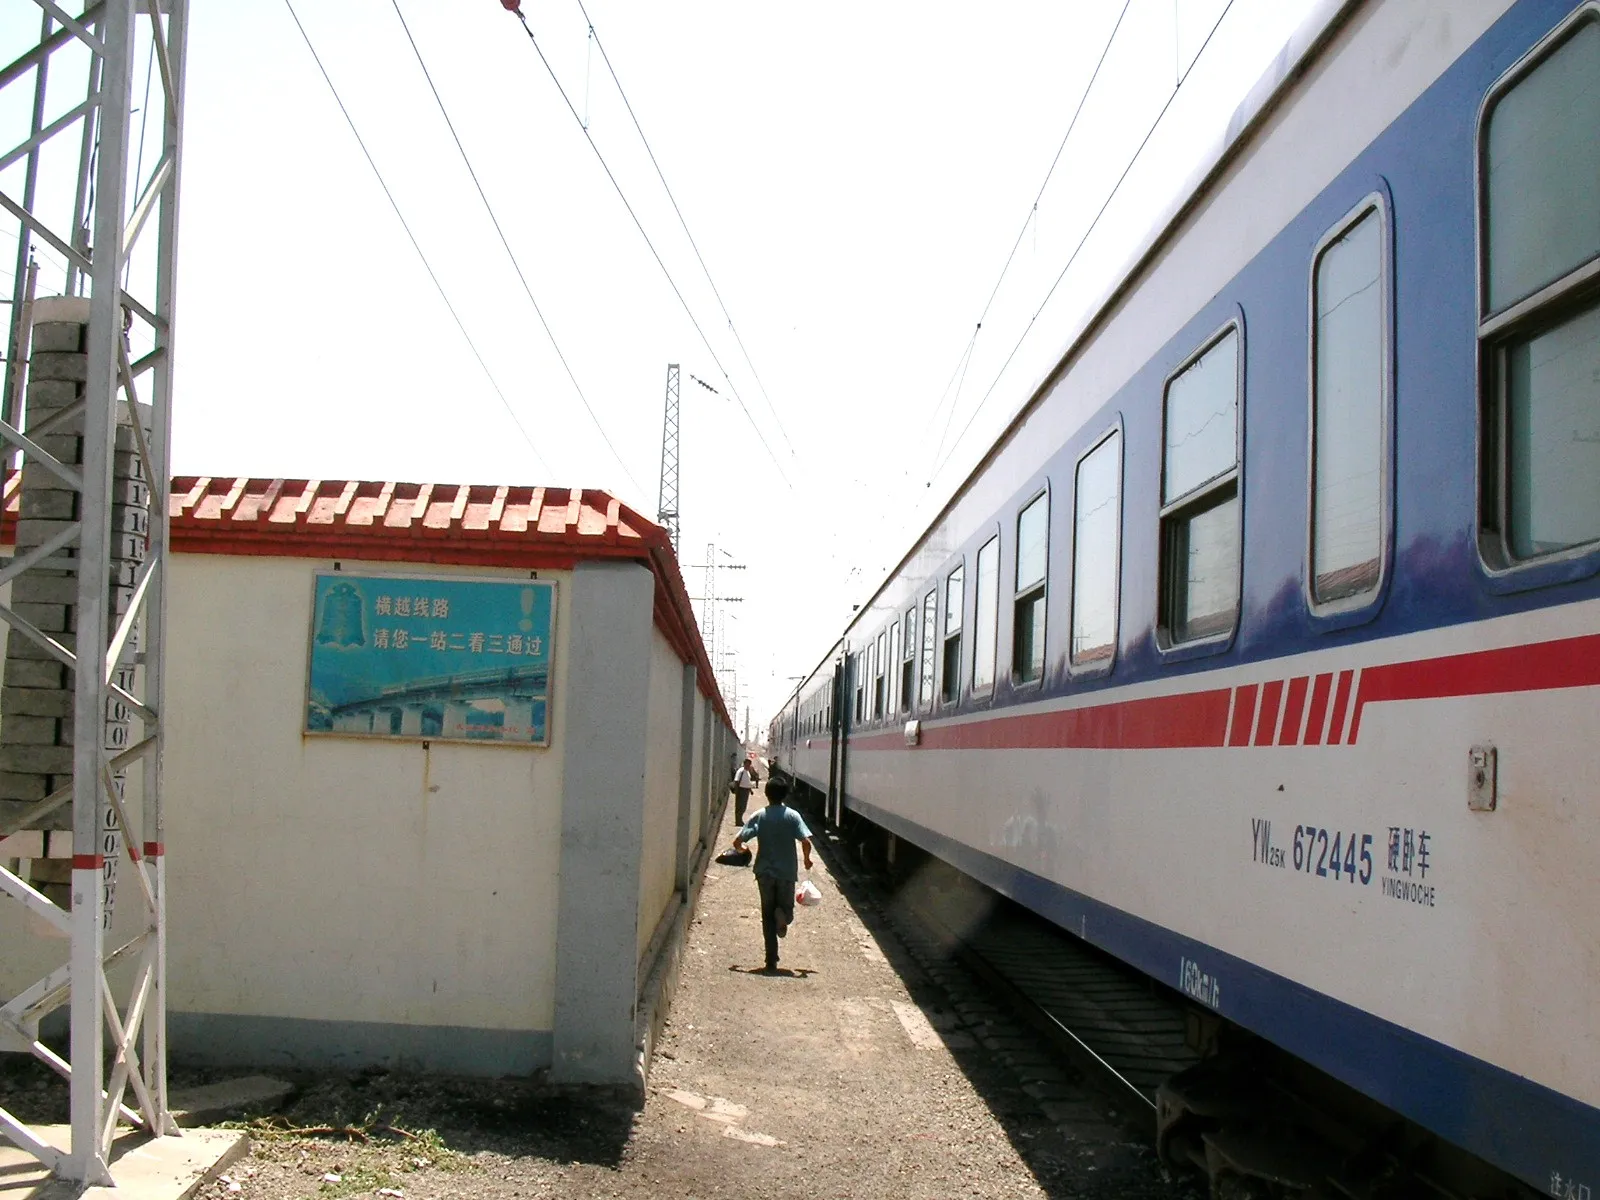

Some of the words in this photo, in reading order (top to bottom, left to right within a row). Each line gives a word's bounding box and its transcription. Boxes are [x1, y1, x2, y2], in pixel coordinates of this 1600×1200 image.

[375, 595, 450, 619] 横越线路
[373, 629, 542, 656] 请您一站二看三通过
[1293, 824, 1373, 885] 672445
[1387, 826, 1431, 879] 硬卧车
[1382, 876, 1436, 907] YINGWOCHE
